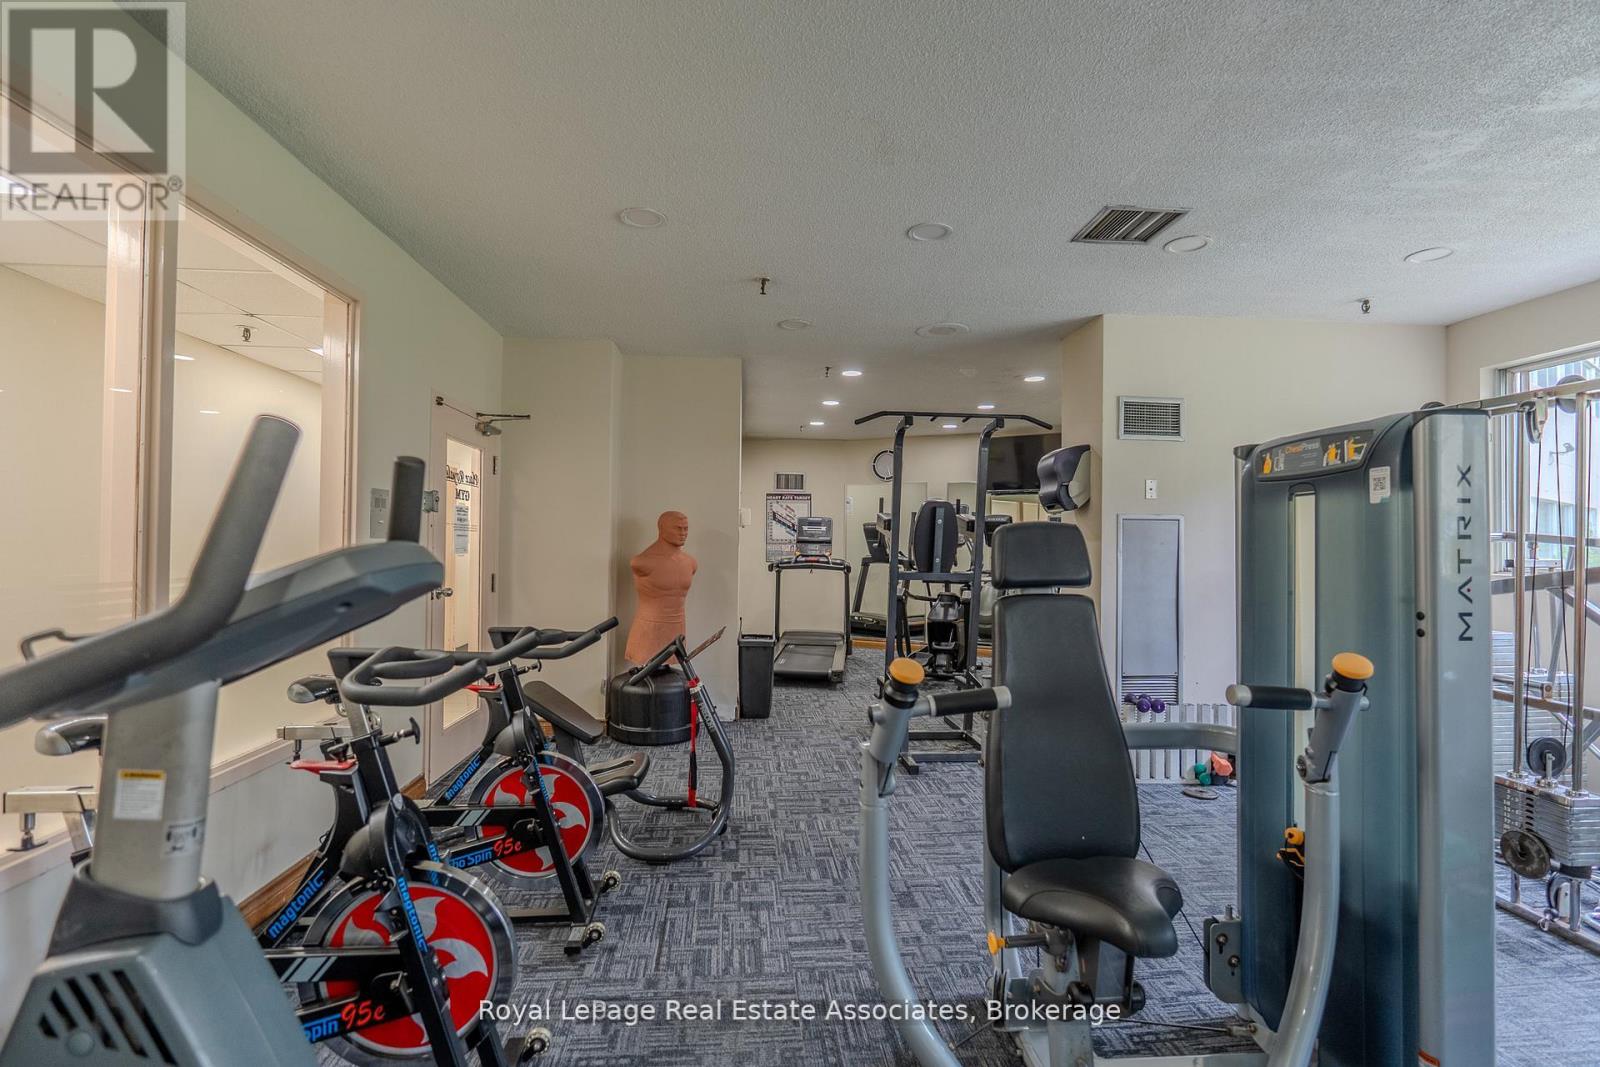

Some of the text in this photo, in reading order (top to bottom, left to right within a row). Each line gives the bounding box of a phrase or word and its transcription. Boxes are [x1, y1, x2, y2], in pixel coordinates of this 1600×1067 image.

[1457, 465, 1473, 641] MATRIX
[445, 755, 481, 800] magtonic
[268, 870, 325, 939] magtonic
[398, 877, 428, 953] magtonic
